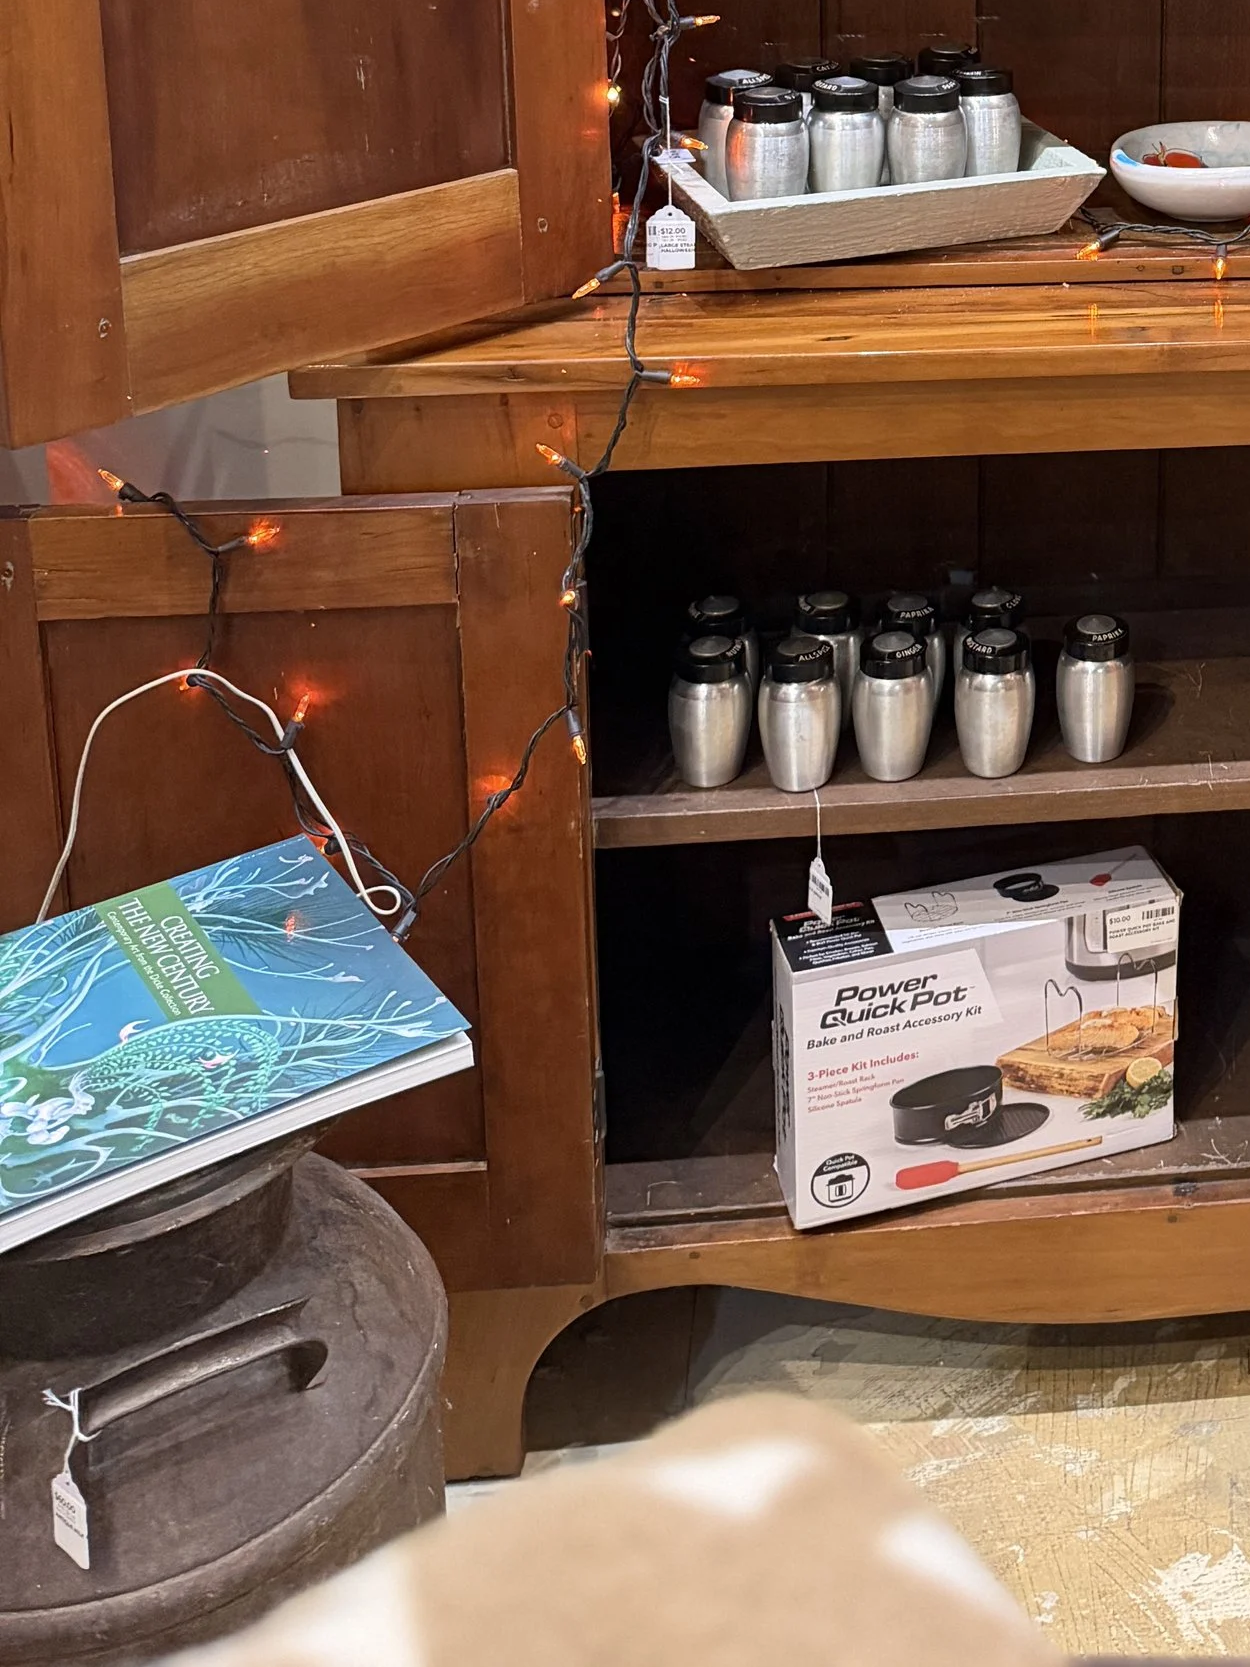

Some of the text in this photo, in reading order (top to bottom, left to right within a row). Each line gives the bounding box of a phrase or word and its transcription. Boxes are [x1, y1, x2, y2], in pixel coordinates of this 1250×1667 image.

[660, 227, 686, 235] $12.00
[899, 606, 935, 619] PAPRIKA
[895, 643, 923, 659] GINGER
[1109, 915, 1131, 925] $10.00
[117, 897, 215, 1015] THE NEW CENTURY
[160, 915, 220, 980] CREATING
[107, 911, 133, 946] Contemporary
[129, 944, 140, 955] Art
[136, 952, 148, 966] from
[144, 964, 154, 975] the
[160, 988, 182, 1016] Collection
[834, 973, 938, 1008] Power
[820, 985, 968, 1030] Quick Pot
[806, 1005, 982, 1051] Bake and Roast Accessory Kit
[807, 1051, 920, 1082] 3-Piece Kit Includes:
[807, 1078, 859, 1094] Steamer/Roast
[817, 1088, 851, 1102] Non-Stick
[807, 1096, 862, 1114] Silicone Spatula
[822, 1159, 859, 1172] Compatible
[825, 1156, 844, 1166] Quick
